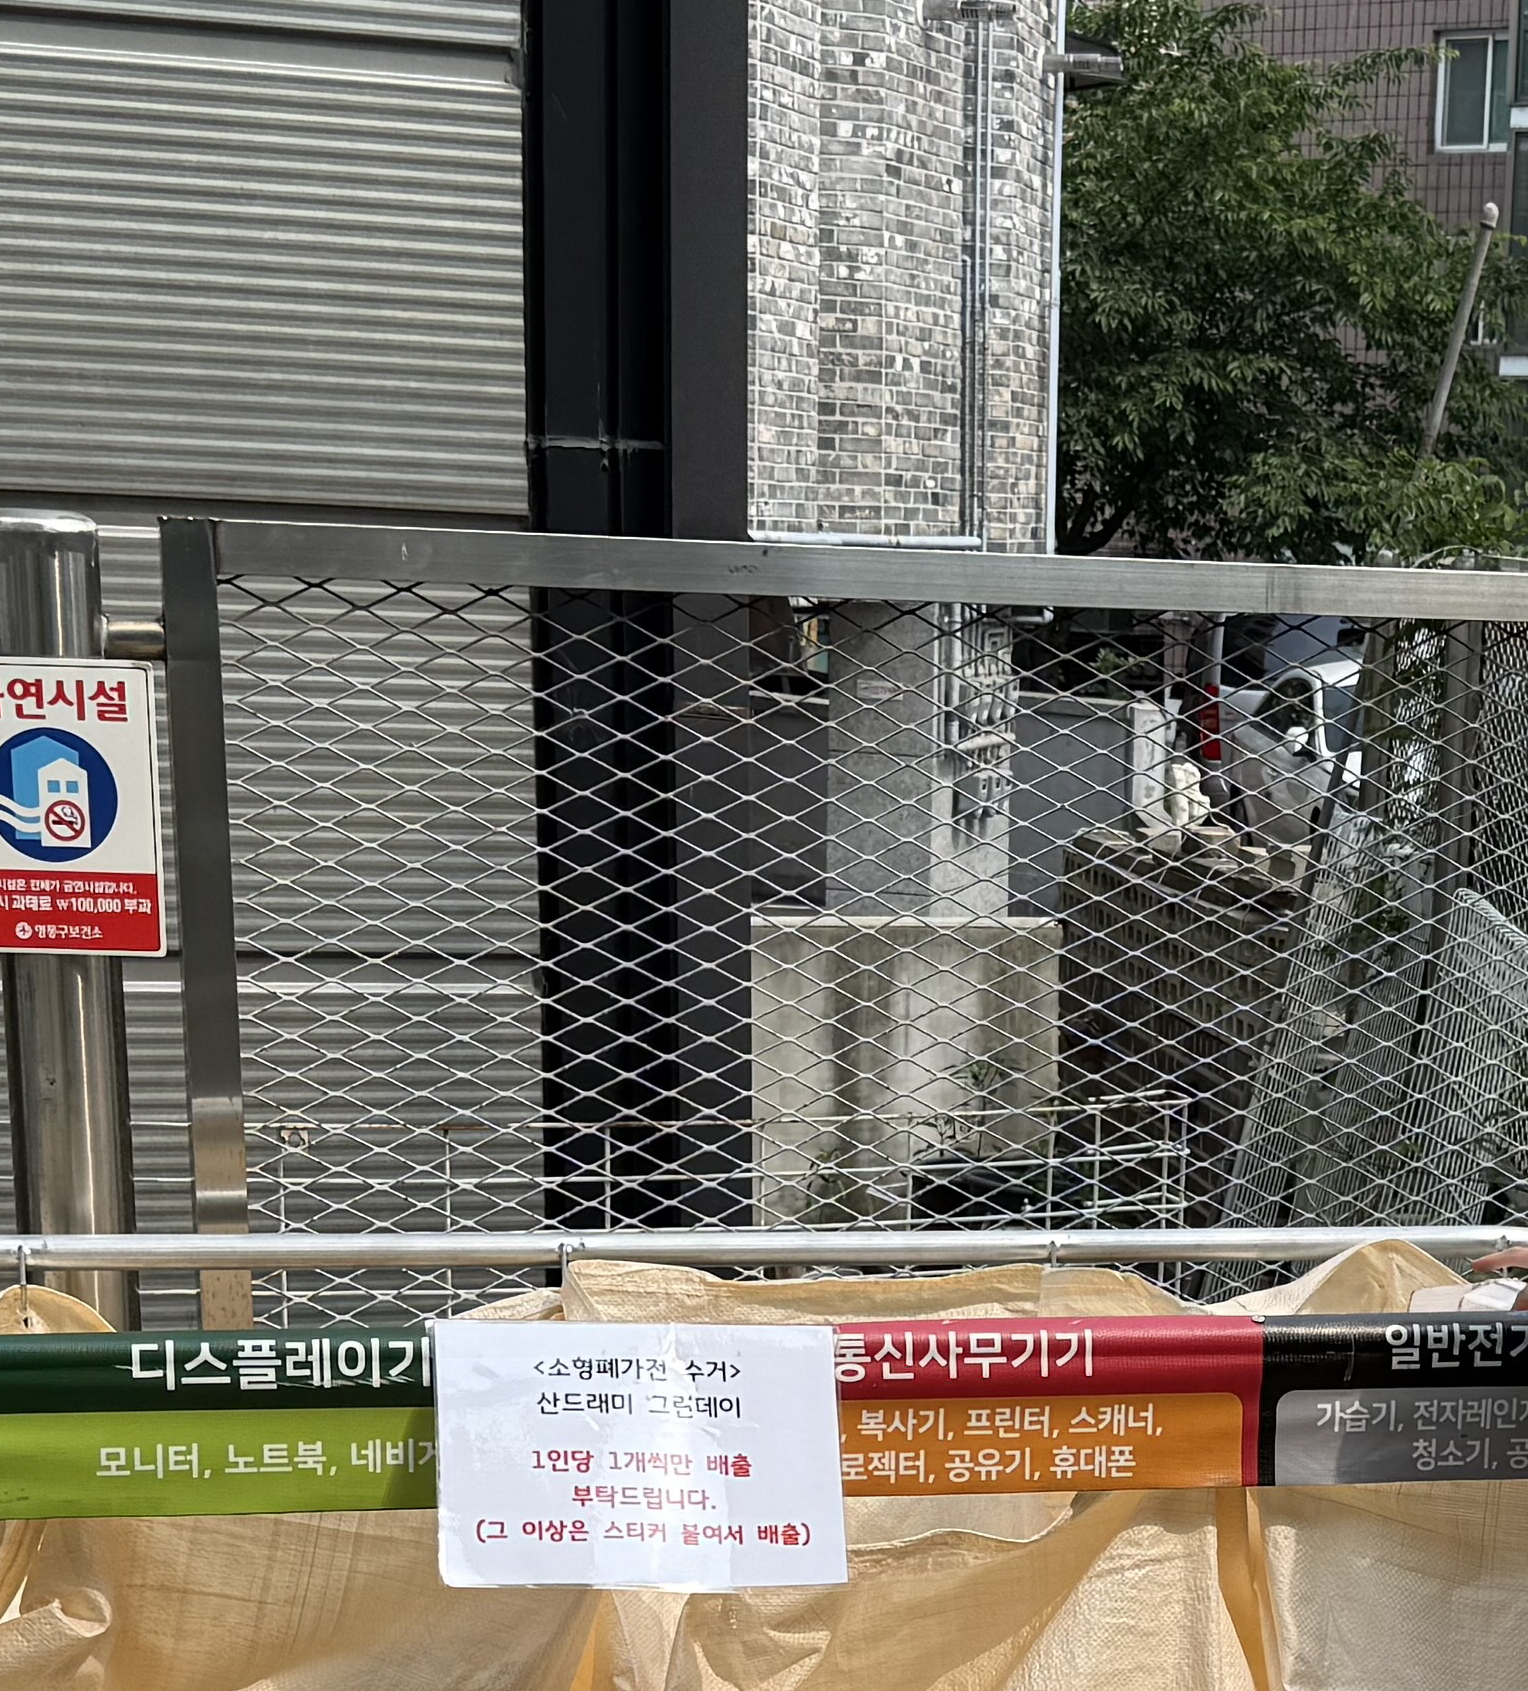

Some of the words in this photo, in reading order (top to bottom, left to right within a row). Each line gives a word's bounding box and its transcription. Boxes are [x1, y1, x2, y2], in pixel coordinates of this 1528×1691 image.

[12, 895, 52, 911] 과태료
[125, 899, 151, 914] 부과
[131, 1336, 430, 1390] 디스플레이기
[533, 1357, 667, 1381] <소형폐가전
[686, 1360, 741, 1383] 수거>
[834, 1329, 1093, 1383] 통신사무기기
[537, 1393, 633, 1416] 산드래미
[648, 1395, 741, 1419] 그린데이
[857, 1407, 954, 1442] 복사기,
[964, 1405, 1060, 1439] 프린터,
[1068, 1402, 1163, 1437] 스캐너,
[1316, 1400, 1403, 1432] 가습기,
[96, 1442, 211, 1479] 모니터,
[224, 1441, 336, 1477] 노트북,
[532, 1450, 594, 1473] 1인당
[609, 1451, 693, 1476] 1개씩만
[706, 1453, 753, 1478] 배출
[841, 1449, 935, 1484] 로젝터,
[945, 1447, 1040, 1482] 공유기,
[1049, 1445, 1136, 1479] 휴대폰
[1412, 1437, 1498, 1471] 청소기,
[572, 1486, 717, 1511] 부탁드립니다.
[476, 1520, 508, 1544] (그
[523, 1520, 589, 1543] 이상은
[604, 1523, 667, 1544] 스티커
[682, 1523, 744, 1546] 붙여서
[758, 1523, 811, 1547] 배출)
